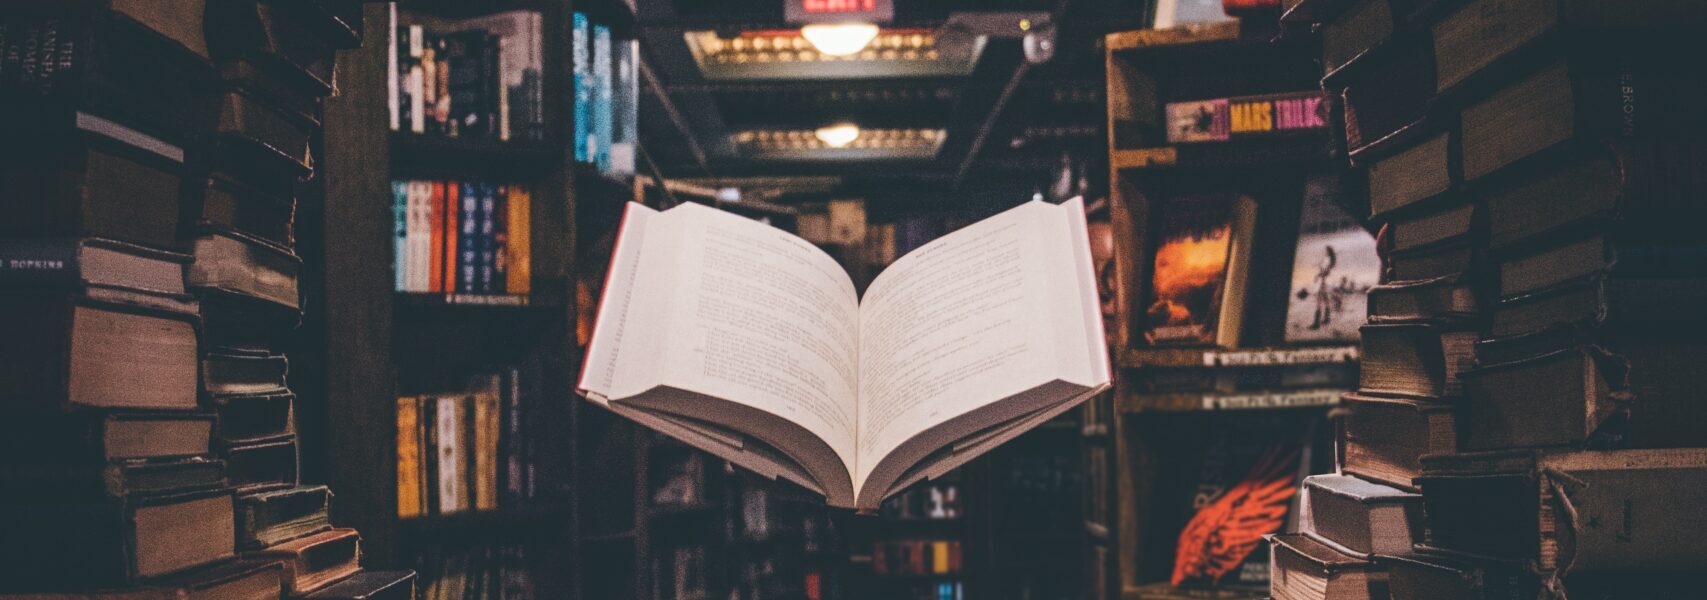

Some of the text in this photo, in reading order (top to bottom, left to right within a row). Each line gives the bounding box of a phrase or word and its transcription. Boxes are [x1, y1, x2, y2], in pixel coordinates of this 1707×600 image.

[59, 41, 74, 71] THE
[1230, 102, 1272, 133] MARS
[10, 259, 64, 269] HOPKINS
